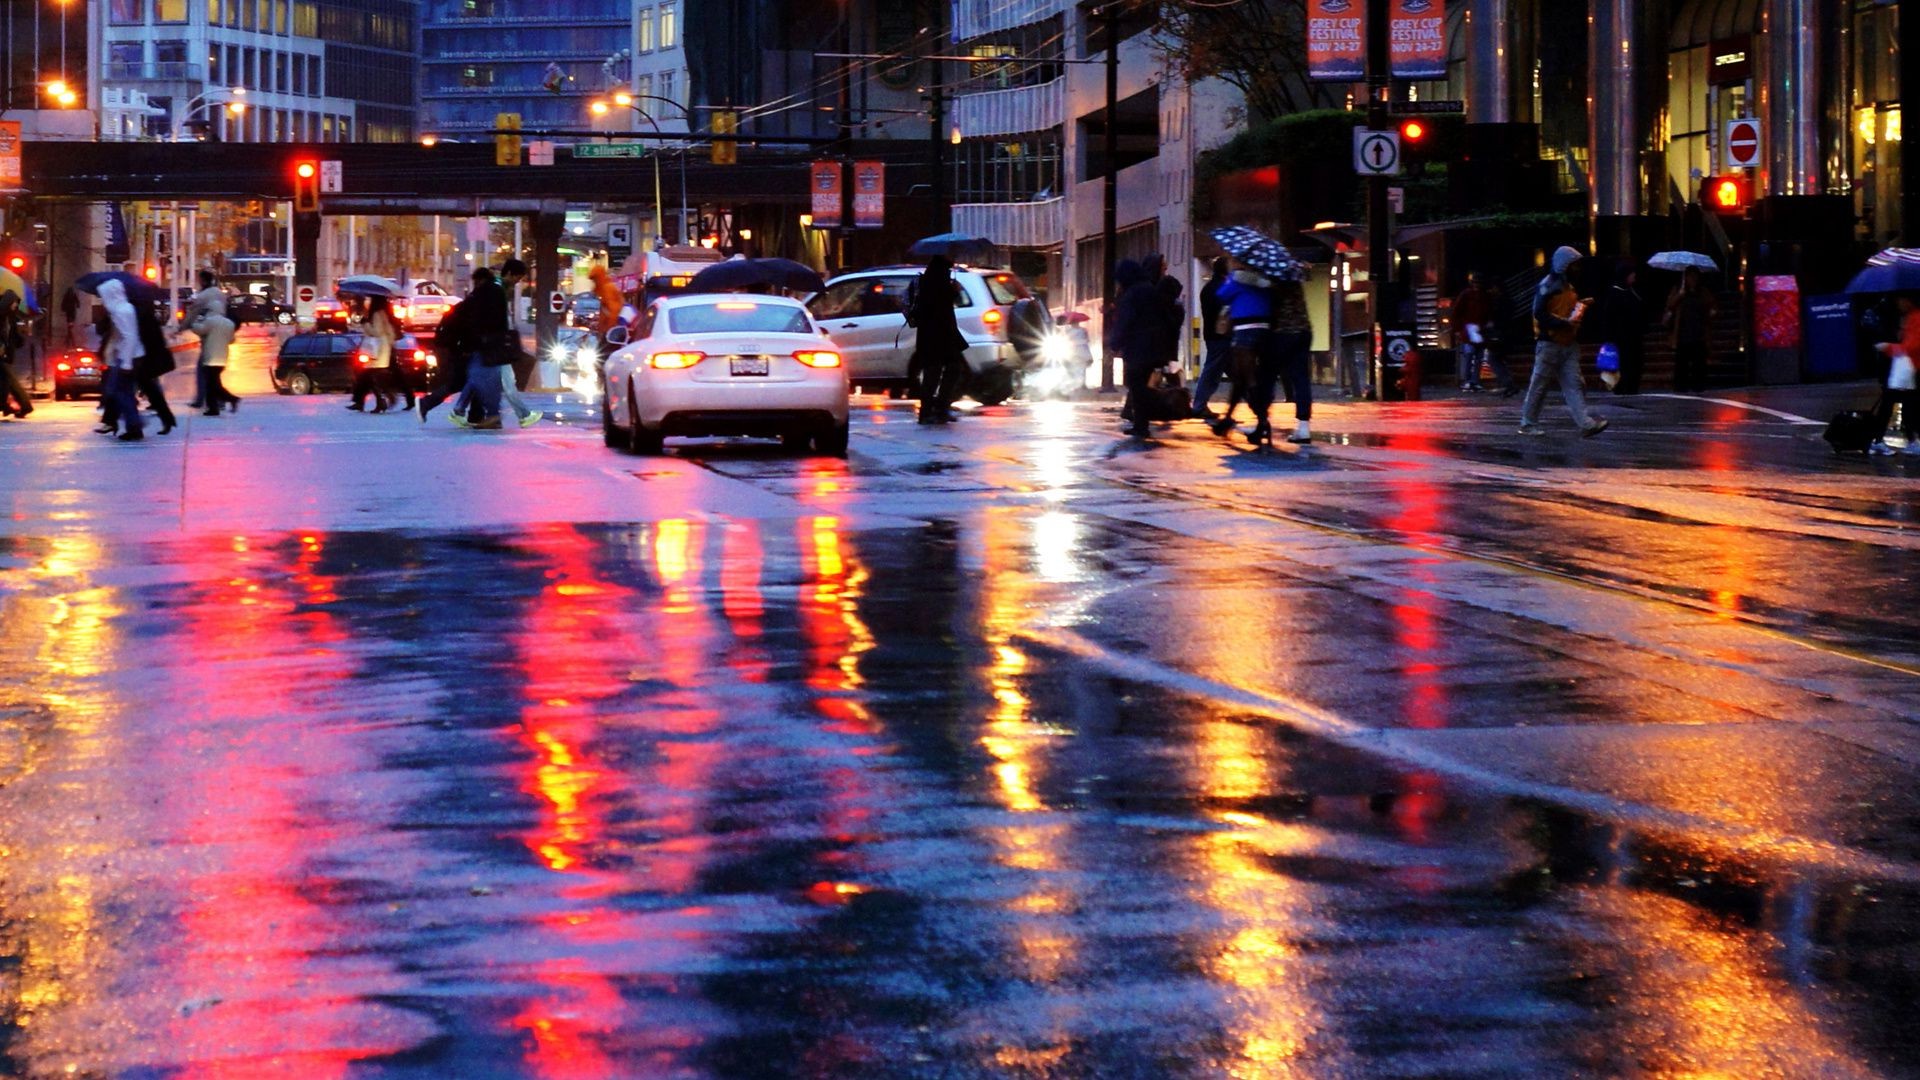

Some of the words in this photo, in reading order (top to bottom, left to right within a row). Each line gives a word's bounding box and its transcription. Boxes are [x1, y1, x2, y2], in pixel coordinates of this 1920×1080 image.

[1309, 18, 1337, 28] GREY
[1340, 18, 1361, 28] CUP
[1391, 19, 1419, 29] GREY
[1421, 17, 1443, 28] CUP
[1309, 28, 1361, 40] FESTIVAL
[1391, 28, 1443, 41] FESTIVAL
[1310, 42, 1331, 52] NOV
[1333, 41, 1361, 52] 24-27
[1391, 42, 1413, 53] NOV
[1415, 41, 1442, 52] 24-27
